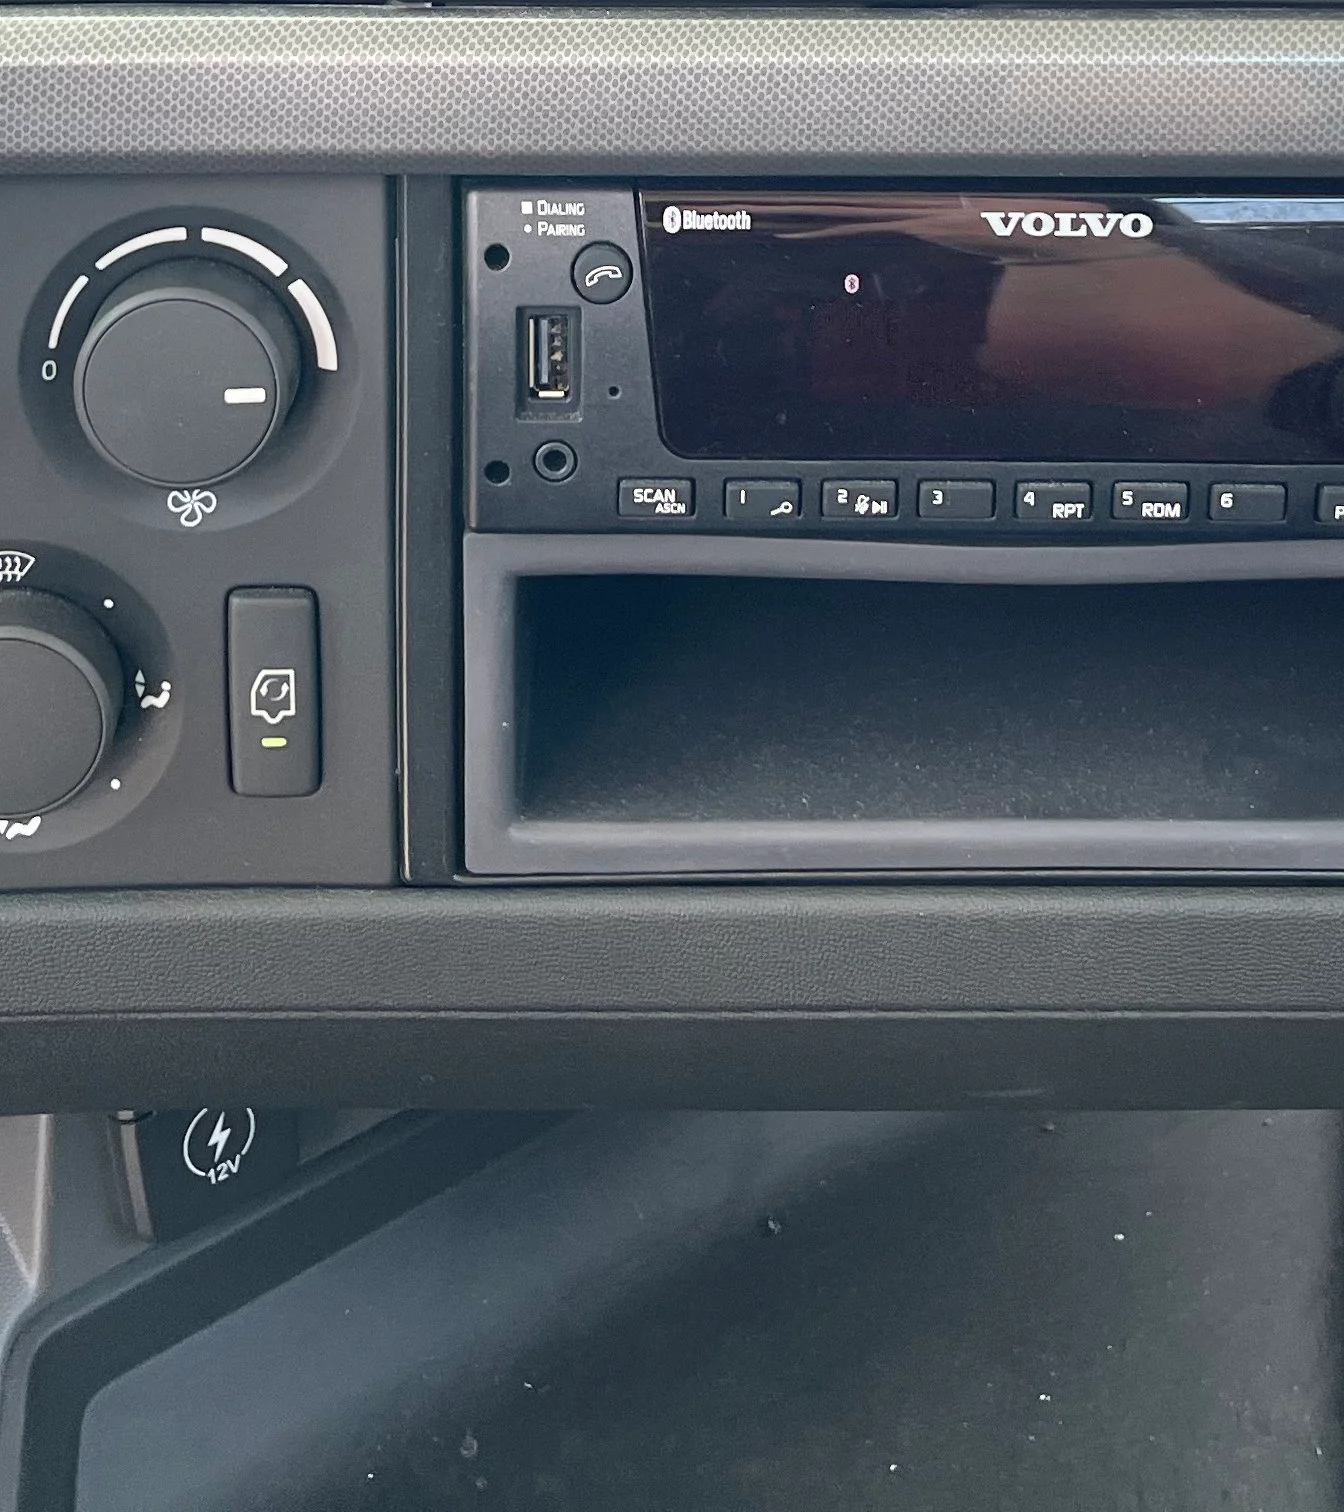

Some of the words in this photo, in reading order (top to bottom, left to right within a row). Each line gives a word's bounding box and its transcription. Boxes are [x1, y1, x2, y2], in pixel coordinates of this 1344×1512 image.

[537, 199, 585, 216] DIALING
[682, 209, 751, 231] Bluetooth
[980, 211, 1154, 238] VOLVO
[537, 222, 586, 236] PAIRING
[633, 488, 676, 503] SCAN
[740, 490, 746, 504] 1
[837, 489, 848, 503] 2
[932, 490, 943, 505] 3
[1023, 491, 1035, 506] 4
[1121, 491, 1134, 506] 5
[1220, 492, 1233, 508] 6
[1052, 503, 1085, 519] RPT
[1141, 503, 1181, 518] RDM
[207, 1154, 241, 1185] 12V
